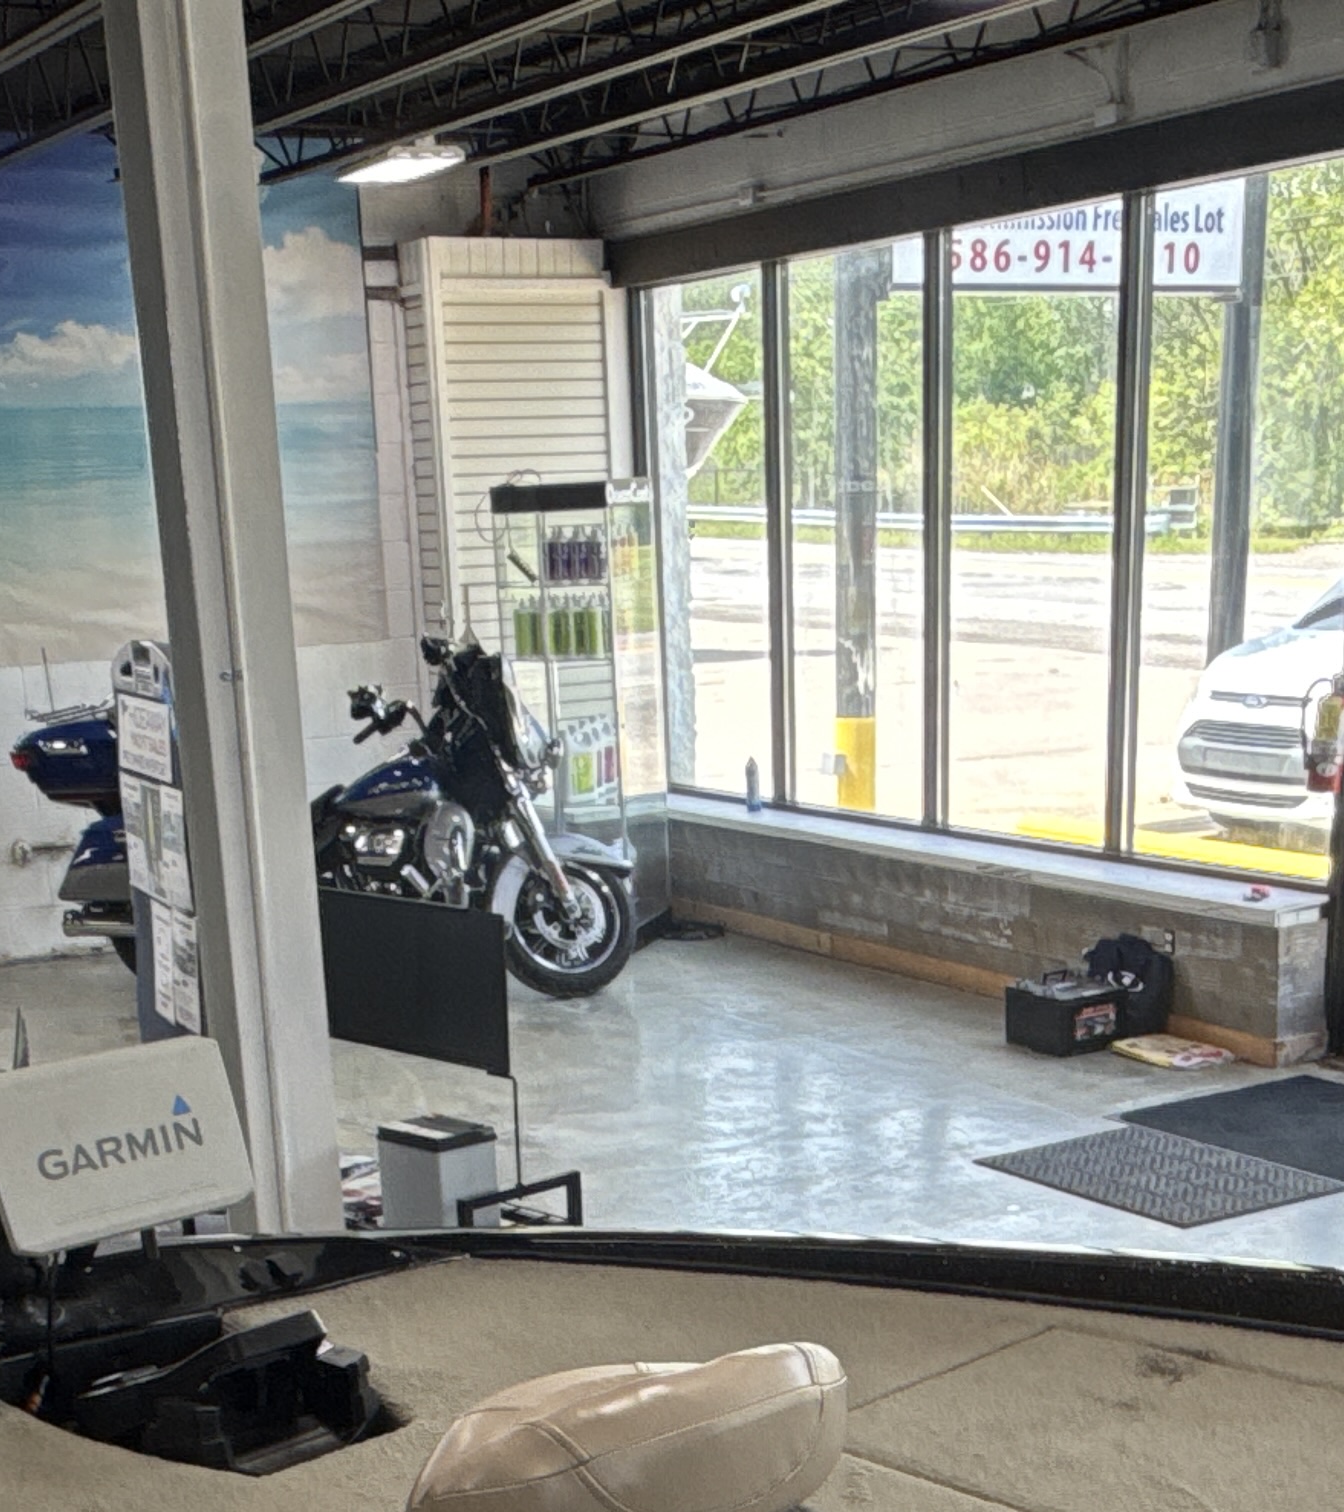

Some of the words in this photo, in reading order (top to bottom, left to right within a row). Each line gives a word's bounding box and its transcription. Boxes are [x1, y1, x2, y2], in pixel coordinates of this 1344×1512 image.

[1093, 205, 1123, 232] Fre
[1153, 203, 1190, 233] ales
[1194, 203, 1225, 234] Lot
[37, 1115, 204, 1181] GARMIN
